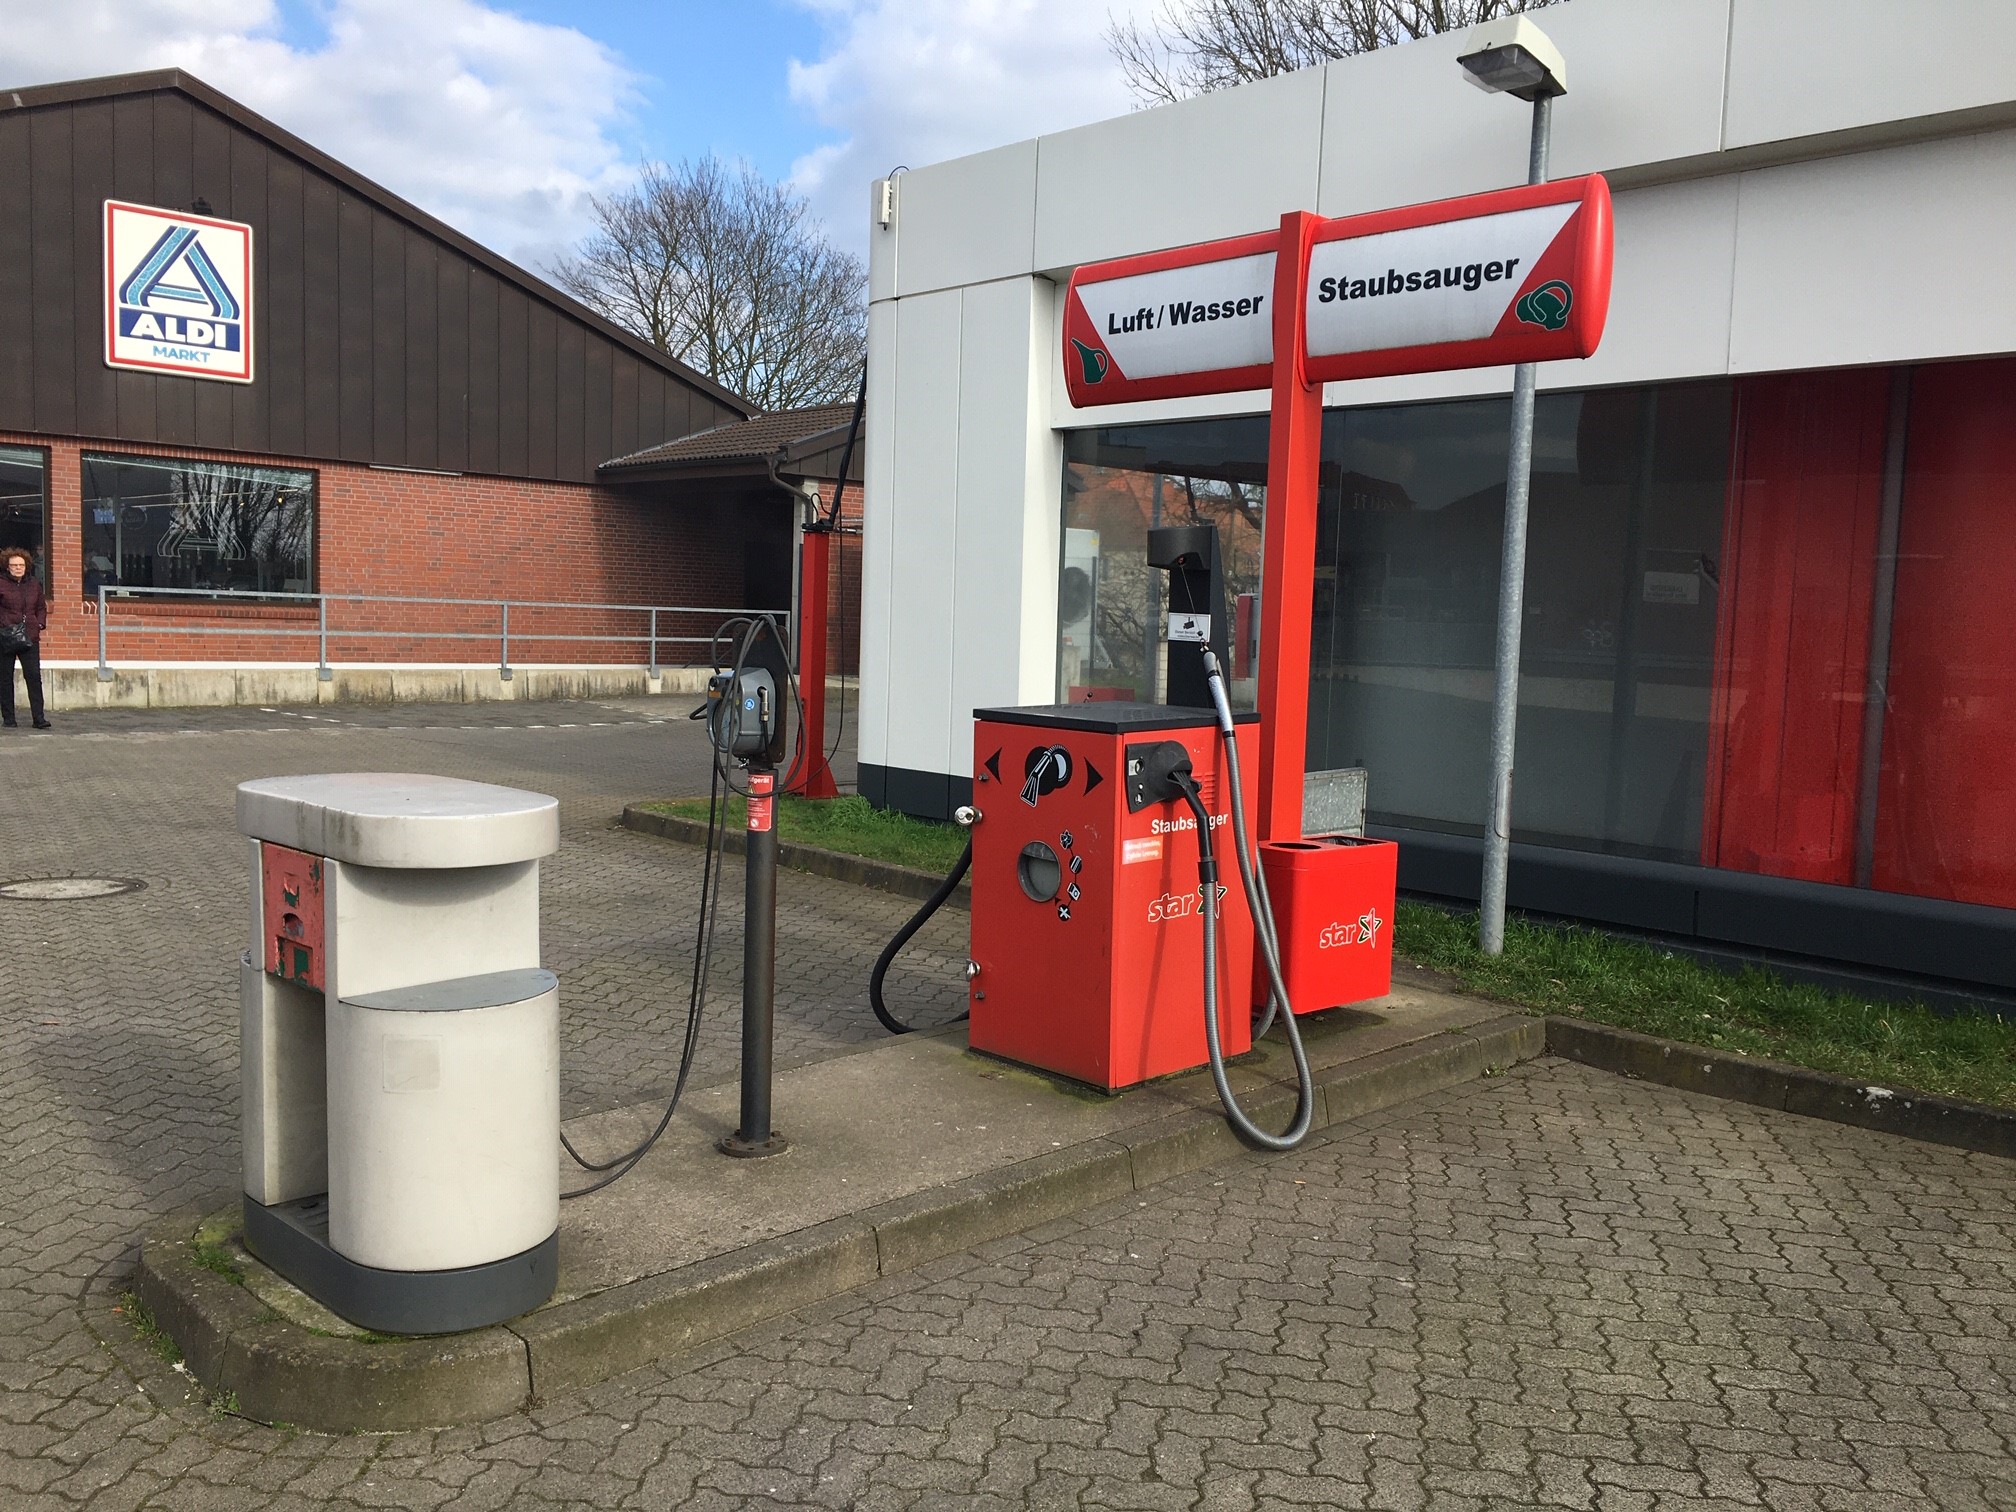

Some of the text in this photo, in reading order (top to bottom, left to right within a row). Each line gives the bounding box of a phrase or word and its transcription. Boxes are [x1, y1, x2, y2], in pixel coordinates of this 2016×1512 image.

[1318, 257, 1520, 303] Staubsauger
[130, 313, 227, 348] ALDI
[153, 345, 211, 363] MARKT
[1147, 892, 1194, 922] star
[1319, 921, 1357, 948] star
